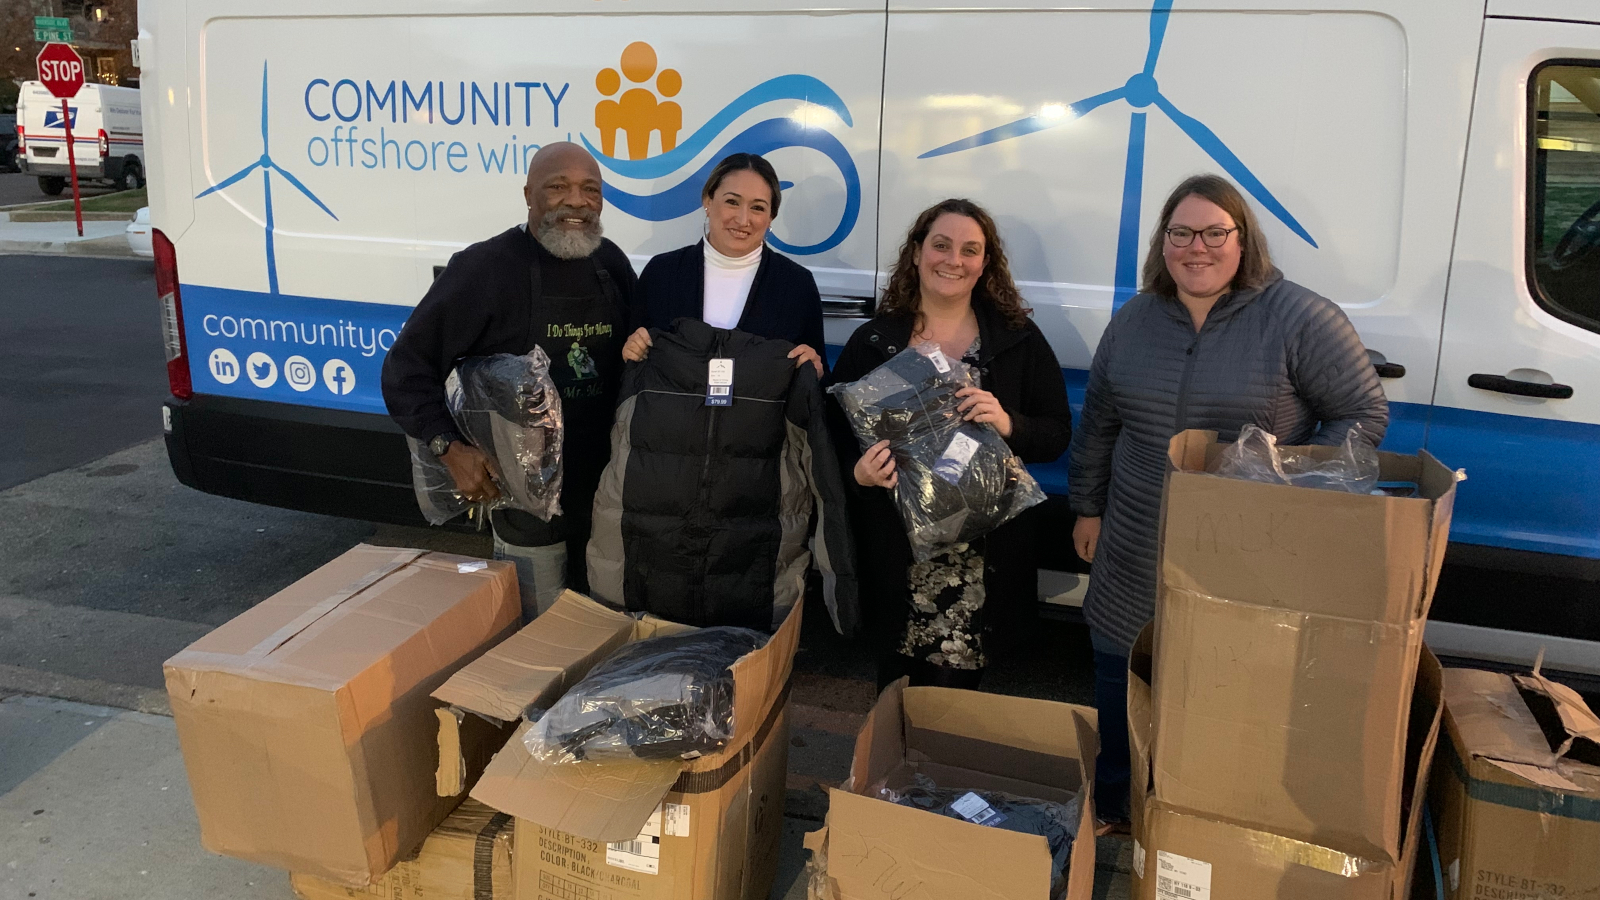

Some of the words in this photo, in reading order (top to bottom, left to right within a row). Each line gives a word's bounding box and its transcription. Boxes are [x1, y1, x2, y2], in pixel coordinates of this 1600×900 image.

[35, 31, 41, 40] E
[43, 31, 60, 41] PINE
[63, 32, 71, 41] ST
[41, 60, 81, 82] STOP
[304, 78, 570, 128] COMMUNITY
[307, 125, 468, 173] offshore
[477, 132, 571, 176] win
[203, 314, 407, 357] communityo
[546, 323, 552, 338] I
[552, 324, 563, 338] Do
[563, 322, 583, 341] Things
[584, 323, 594, 338] For
[595, 321, 612, 338] Money
[1195, 512, 1298, 556] MLK
